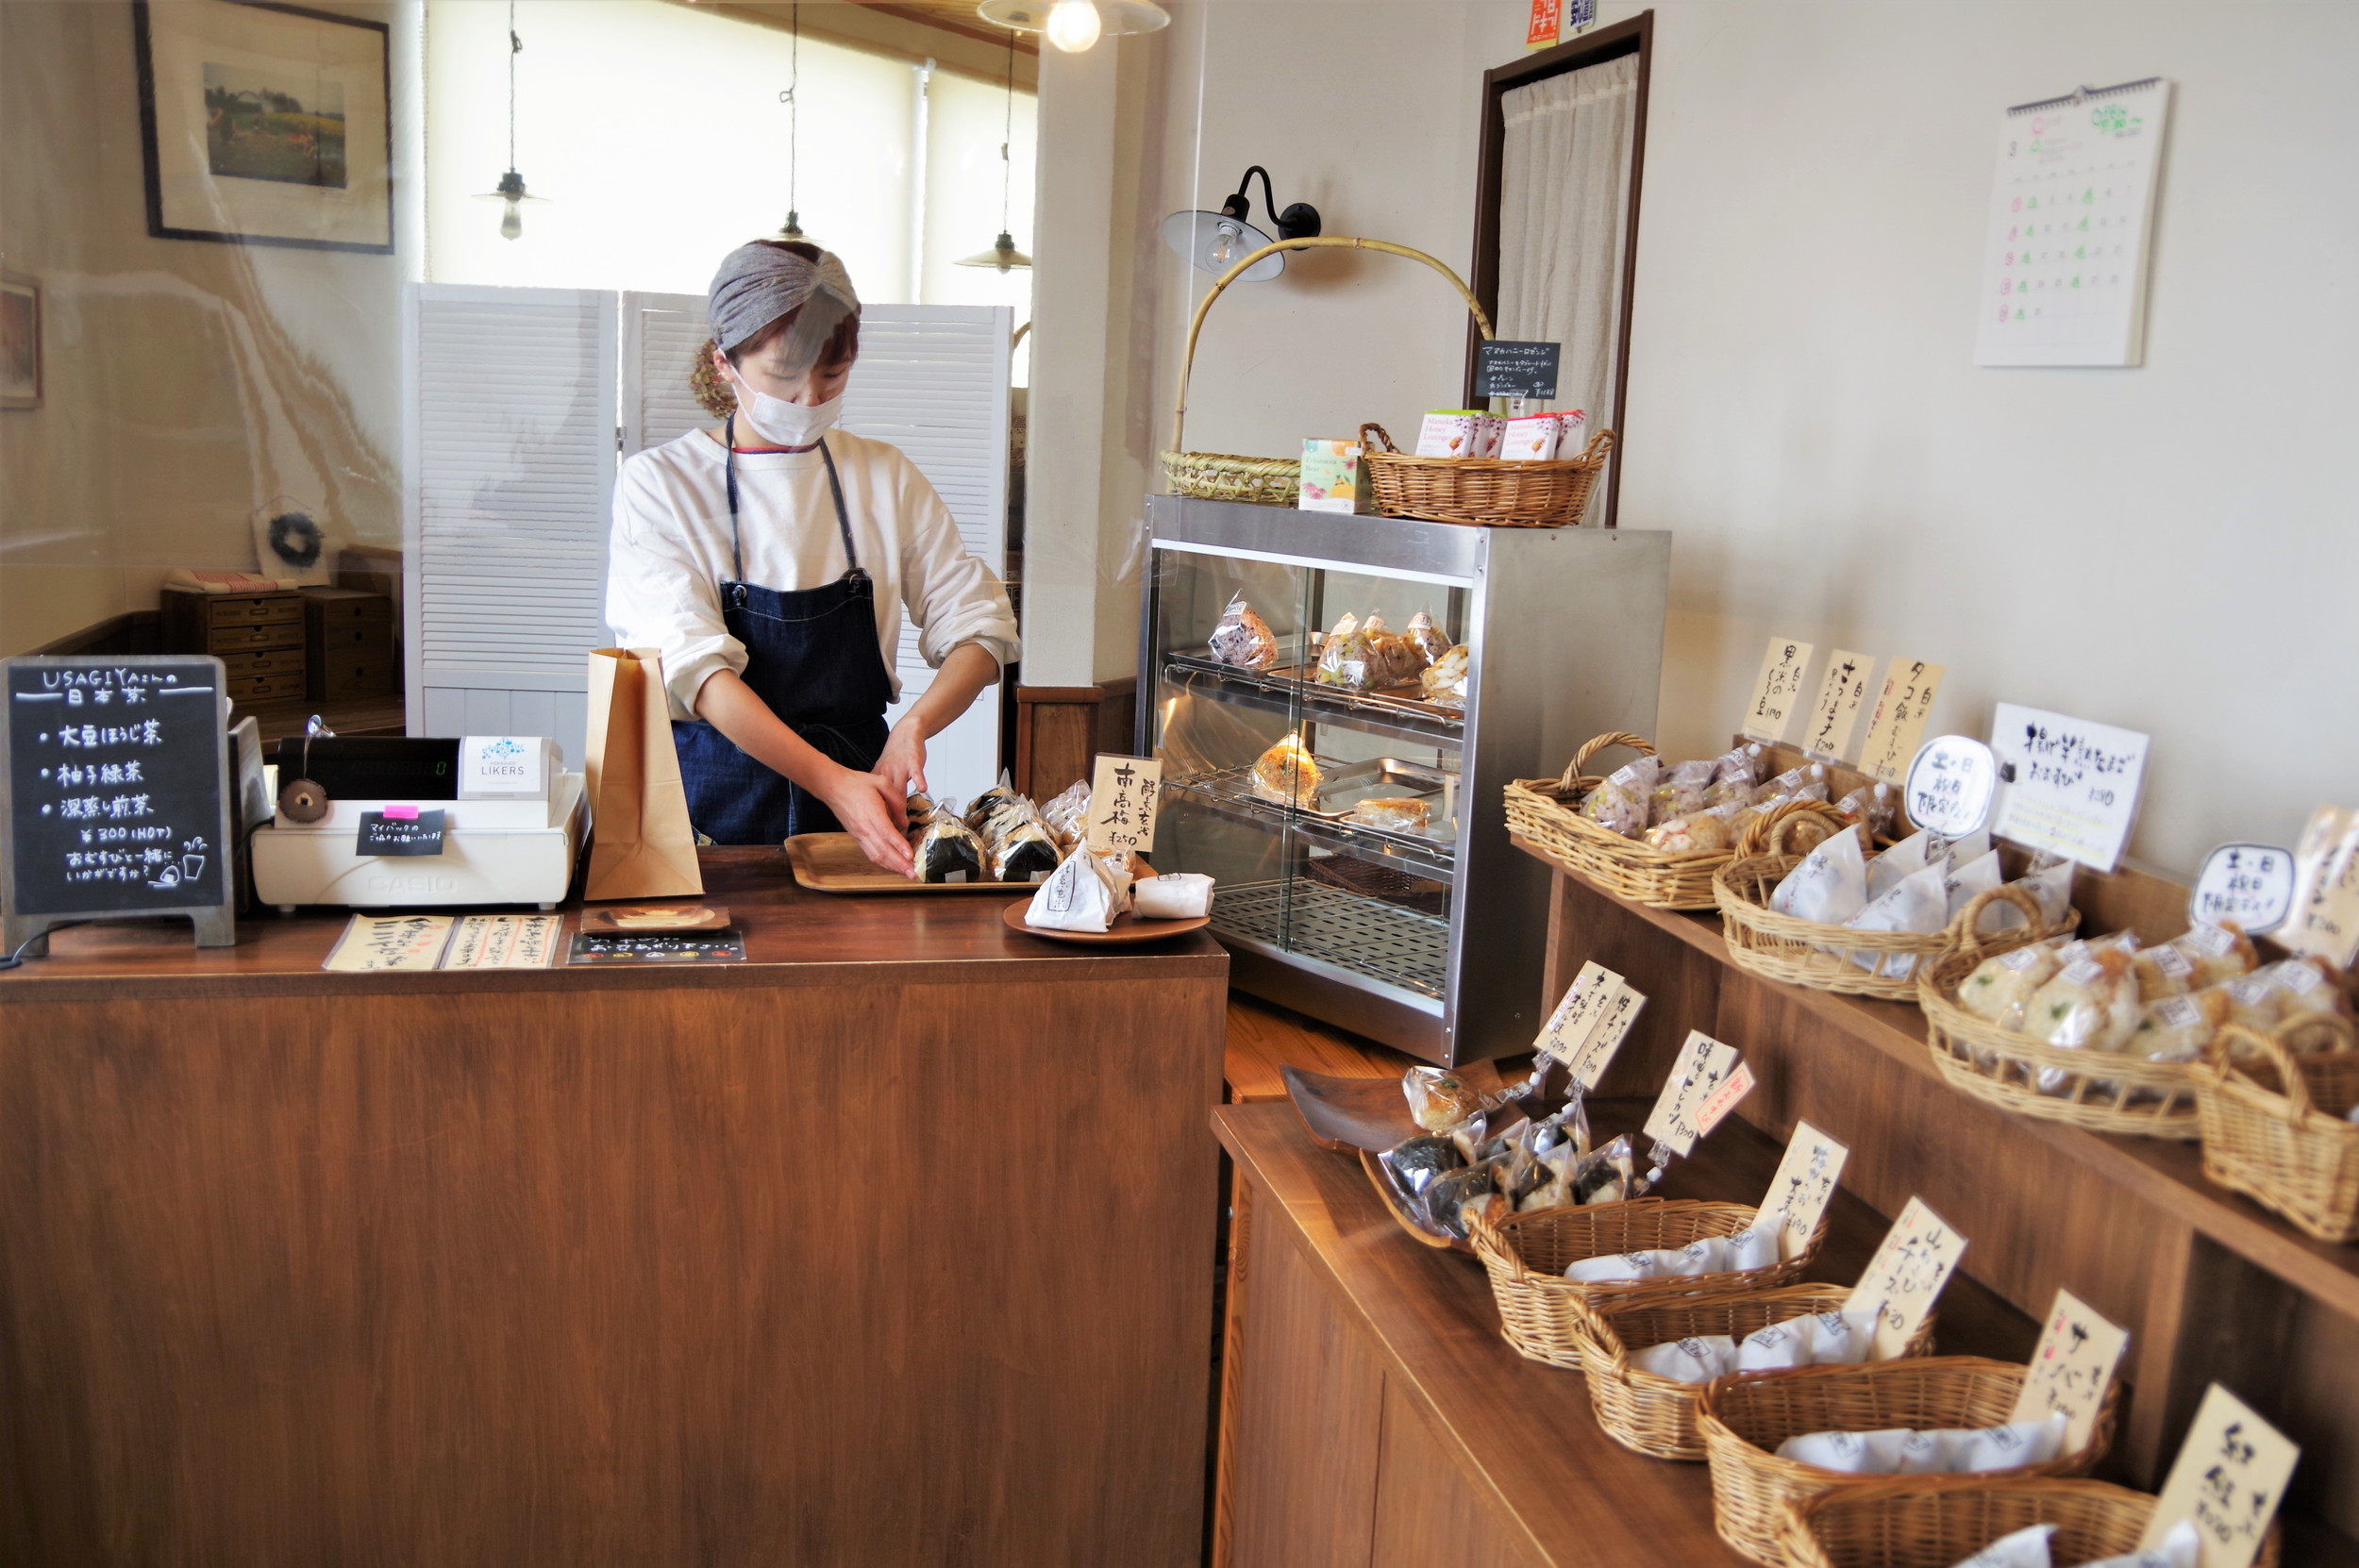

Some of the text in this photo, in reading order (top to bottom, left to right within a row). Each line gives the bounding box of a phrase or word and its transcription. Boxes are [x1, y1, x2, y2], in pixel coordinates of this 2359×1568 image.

[68, 687, 146, 706] 日本茶
[59, 719, 162, 749] 大豆ほうじ茶
[57, 759, 143, 788] 柚子緑茶
[481, 766, 525, 776] LIKERS
[1100, 762, 1135, 826] 南高梅
[59, 793, 155, 819] 深蒸し煎茶
[1108, 830, 1138, 845] ¥250
[369, 876, 459, 893] CASIO
